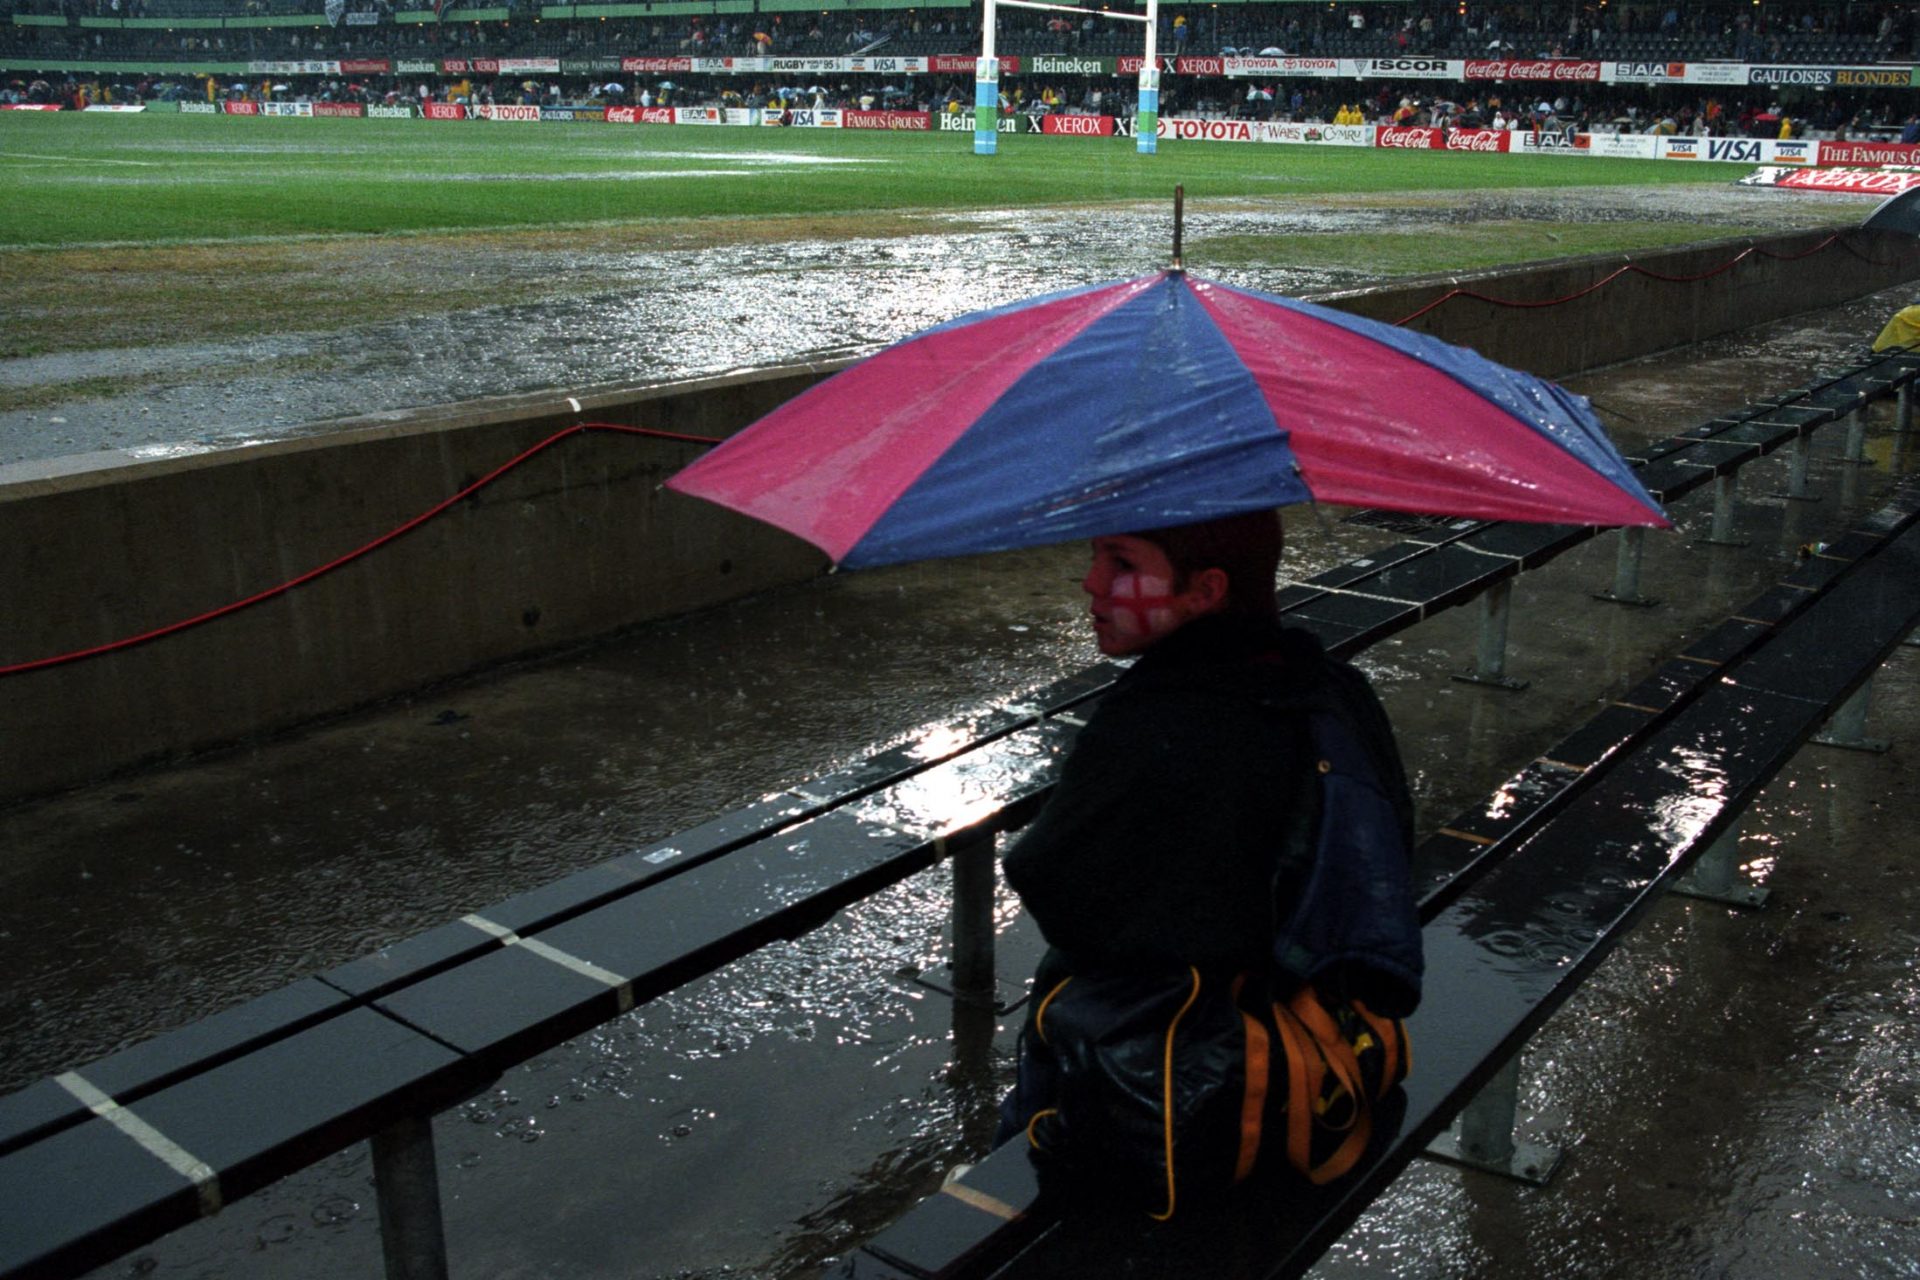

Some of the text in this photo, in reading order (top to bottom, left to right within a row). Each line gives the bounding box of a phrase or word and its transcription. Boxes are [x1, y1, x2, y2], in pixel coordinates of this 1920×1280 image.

[444, 60, 466, 72] XEROX
[476, 60, 498, 72] XEROX
[774, 60, 805, 70] RUGBY
[824, 60, 834, 70] 95
[874, 59, 896, 70] VISA
[936, 58, 976, 70] THE FAMOU
[1032, 57, 1102, 73] Heineken
[1164, 58, 1176, 74] X
[1180, 59, 1220, 74] XEROX
[1242, 59, 1336, 69] TOYOTA TOYOTA
[1372, 60, 1447, 71] ISCOR
[1466, 62, 1600, 80] Coca-Cola Coca-Cola Coca-Cola
[1616, 63, 1666, 76] SAA
[1750, 70, 1832, 84] GAULOISES
[1836, 72, 1910, 86] BLONDES
[368, 104, 411, 118] Heineken
[416, 105, 426, 118] X
[432, 106, 457, 118] XEROX
[496, 106, 539, 120] TOYOTA
[608, 108, 670, 123] Coca-Cola Coca-Cola
[847, 112, 926, 129] FAMOUS GROUSE
[940, 114, 1016, 132] Heinen
[1028, 116, 1042, 133] X
[1054, 117, 1101, 134] XEROX
[1114, 118, 1129, 136] X
[1172, 120, 1250, 140] TOYOTA
[1268, 124, 1300, 140] WALES
[1323, 127, 1362, 142] CYMRU
[1381, 128, 1502, 151] Coca-Cola Coca-Cola
[1672, 144, 1692, 153] VISA
[1708, 140, 1761, 161] VISA
[1780, 148, 1801, 156] VISA
[1823, 146, 1850, 161] THE
[1852, 146, 1908, 164] FAMOUS
